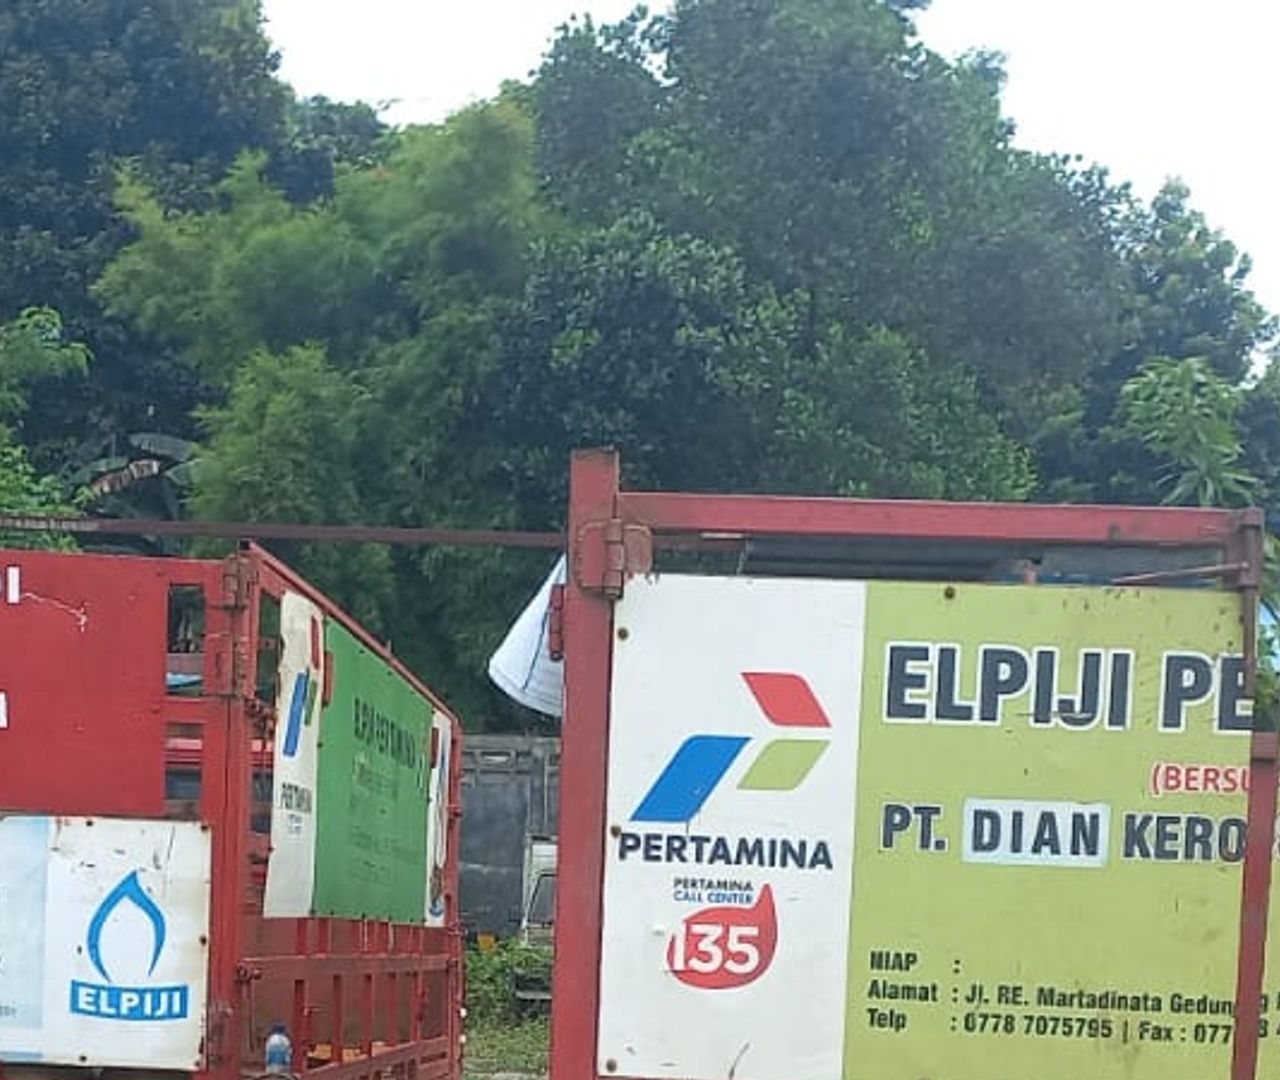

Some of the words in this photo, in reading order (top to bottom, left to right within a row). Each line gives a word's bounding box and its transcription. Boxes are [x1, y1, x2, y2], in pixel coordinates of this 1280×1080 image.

[885, 644, 1131, 729] ELPIJI
[882, 804, 947, 851] PT.
[972, 809, 1100, 856] DIAN
[618, 832, 833, 870] PERTAMINA
[673, 877, 754, 892] PERTAMINA
[674, 889, 702, 903] CALL
[672, 920, 759, 975] 135
[870, 951, 918, 972] NIAP
[77, 988, 181, 1016] ELPIJI
[868, 979, 938, 1002] Alamat
[998, 986, 1029, 1006] RE.
[1037, 987, 1162, 1013] Martadinata
[867, 1008, 907, 1033] Telp
[964, 1013, 1016, 1035] 0778
[1024, 1016, 1114, 1039] 7075795
[1138, 1020, 1173, 1042] Fax
